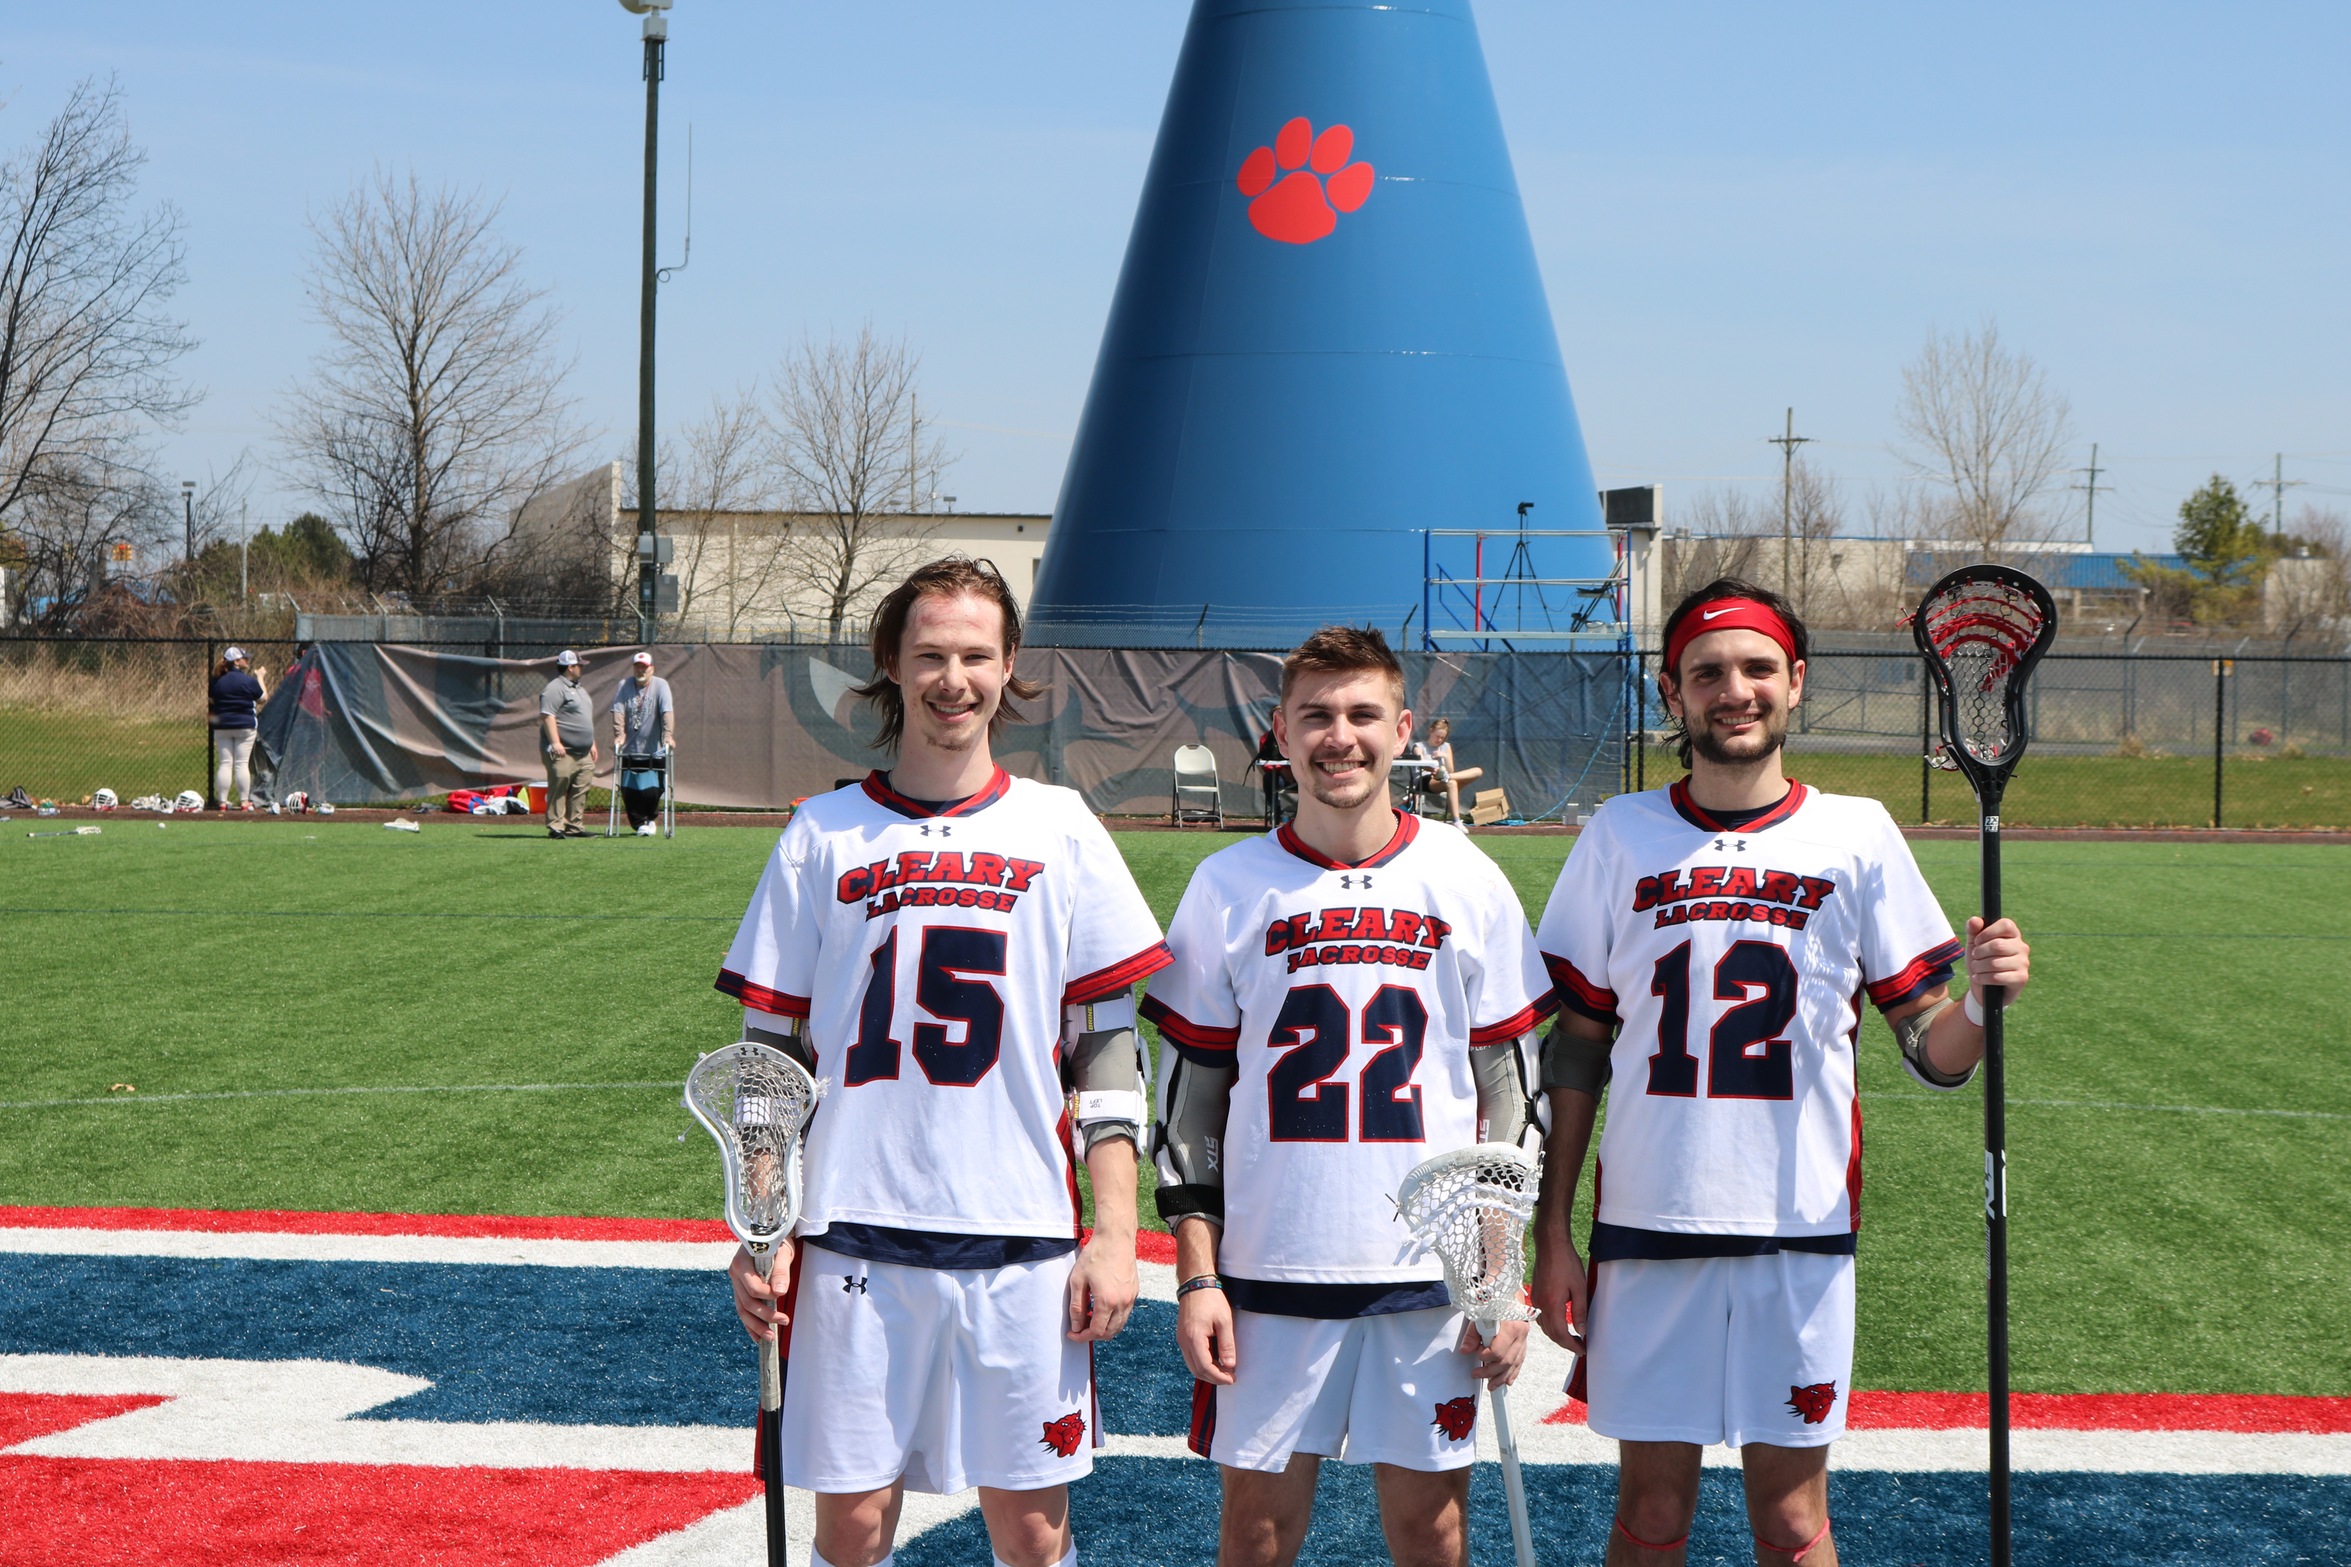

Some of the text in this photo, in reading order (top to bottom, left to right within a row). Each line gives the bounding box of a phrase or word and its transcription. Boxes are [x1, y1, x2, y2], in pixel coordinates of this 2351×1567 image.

[837, 851, 1045, 904] CLEARY
[1632, 866, 1835, 912] CLEARY
[866, 887, 1018, 922] LACROSSE
[1654, 901, 1810, 930] LACROSSE
[1265, 907, 1452, 956] CLEARY
[1287, 945, 1431, 974] LACROSSE
[844, 925, 1007, 1087] 15
[1086, 1006, 1094, 1031] BRINE
[1646, 939, 1798, 1100] 12
[1267, 983, 1428, 1143] 22
[1479, 1119, 1490, 1144] ST
[1204, 1135, 1219, 1174] STX
